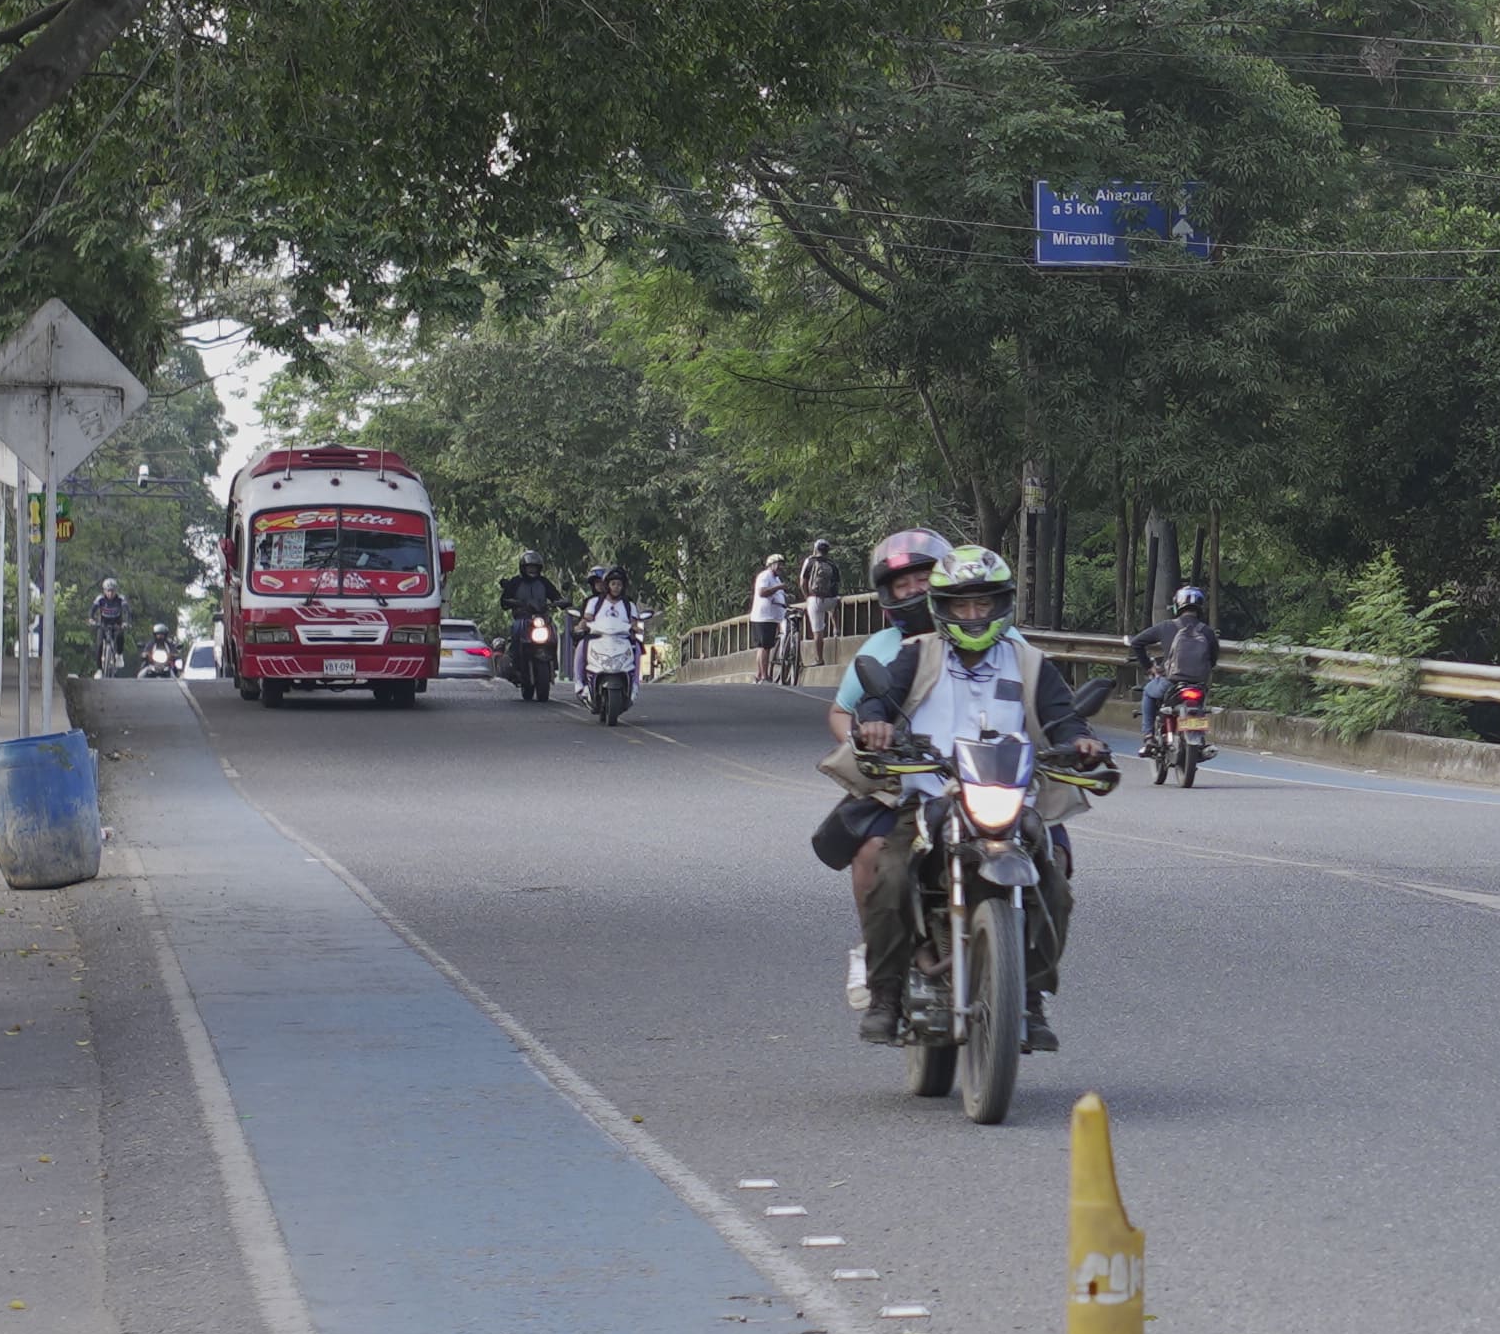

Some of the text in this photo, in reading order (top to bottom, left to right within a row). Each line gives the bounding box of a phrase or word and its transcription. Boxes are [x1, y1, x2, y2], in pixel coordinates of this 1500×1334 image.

[1052, 203, 1103, 215] a 5 Km.
[1052, 233, 1115, 246] Miravalle
